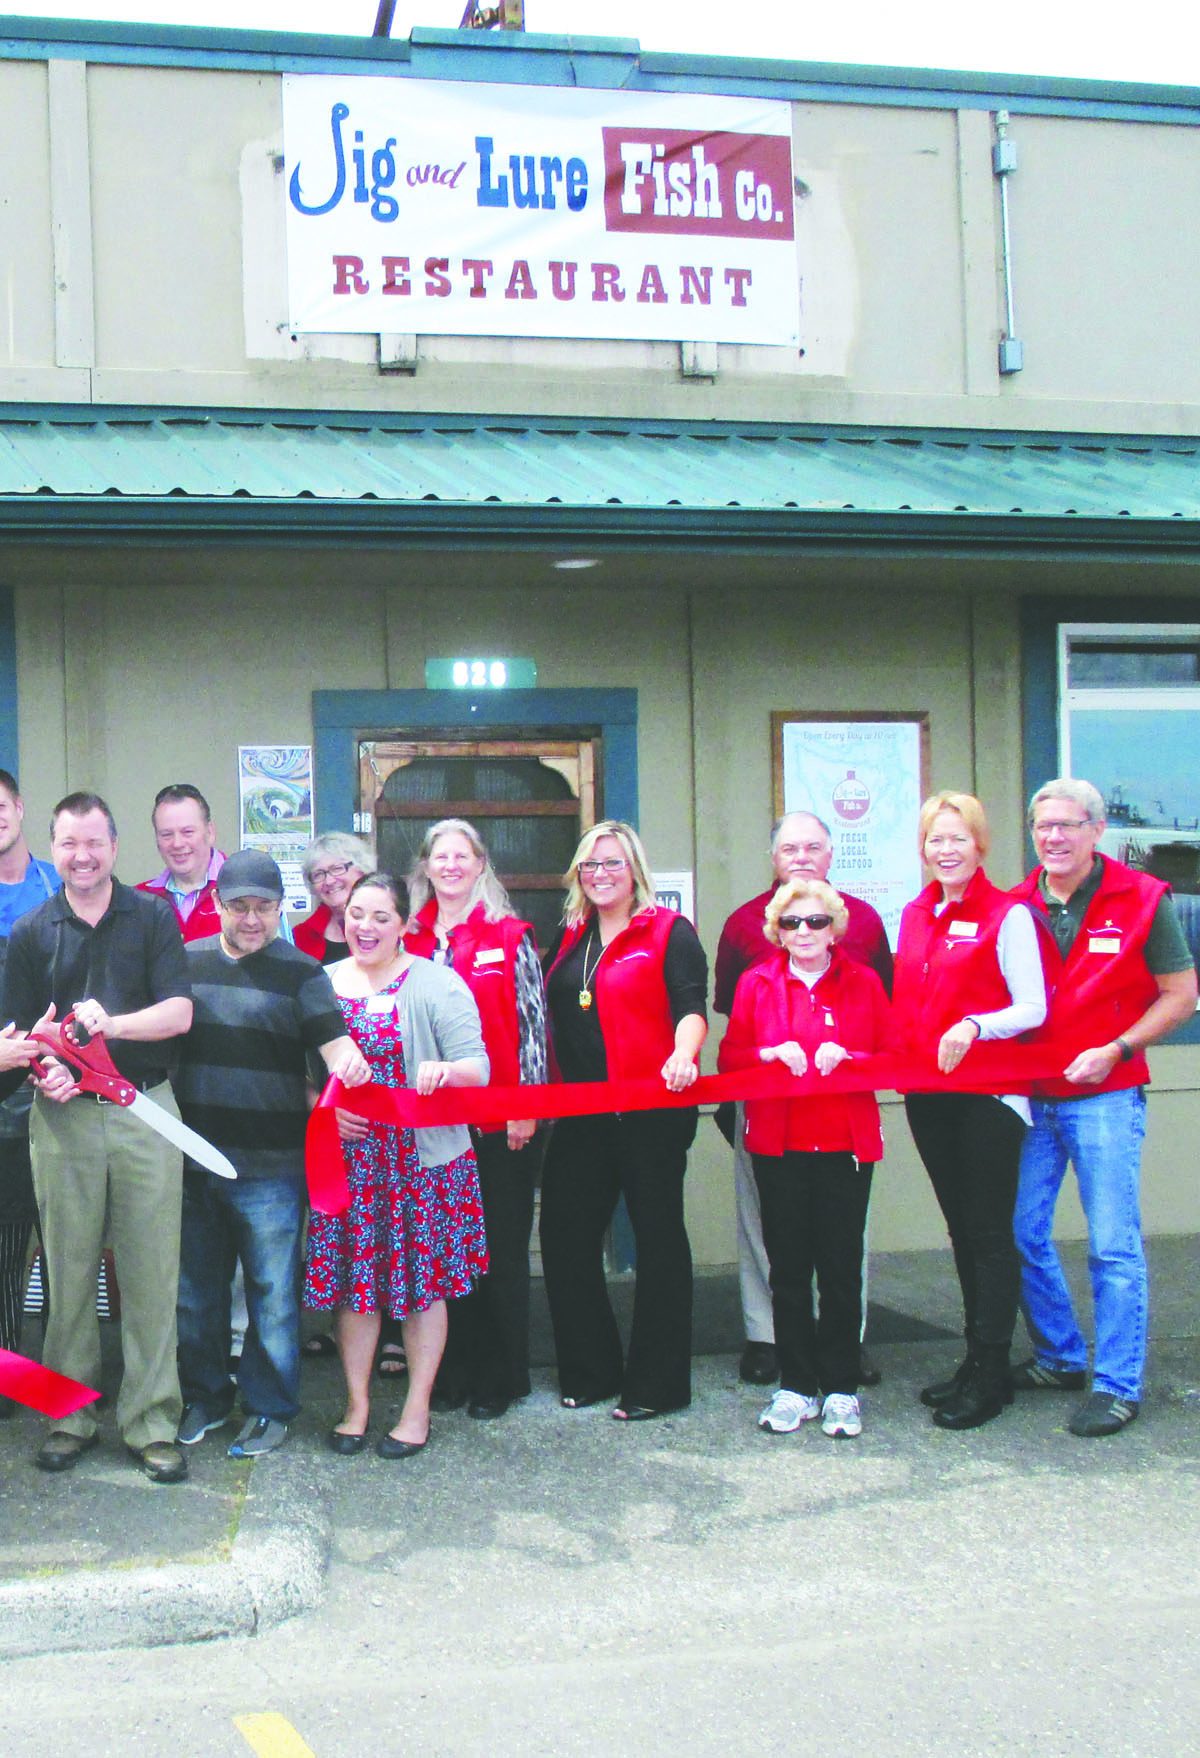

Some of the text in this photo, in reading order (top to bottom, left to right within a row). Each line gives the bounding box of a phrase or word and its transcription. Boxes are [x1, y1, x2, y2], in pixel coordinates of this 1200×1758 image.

[290, 103, 784, 223] Jig and Lure Fish Co.
[333, 254, 752, 307] RESTAURANT
[841, 833, 867, 843] FRESH
[841, 846, 867, 856] LOCAL
[836, 859, 873, 869] SEAFOOD
